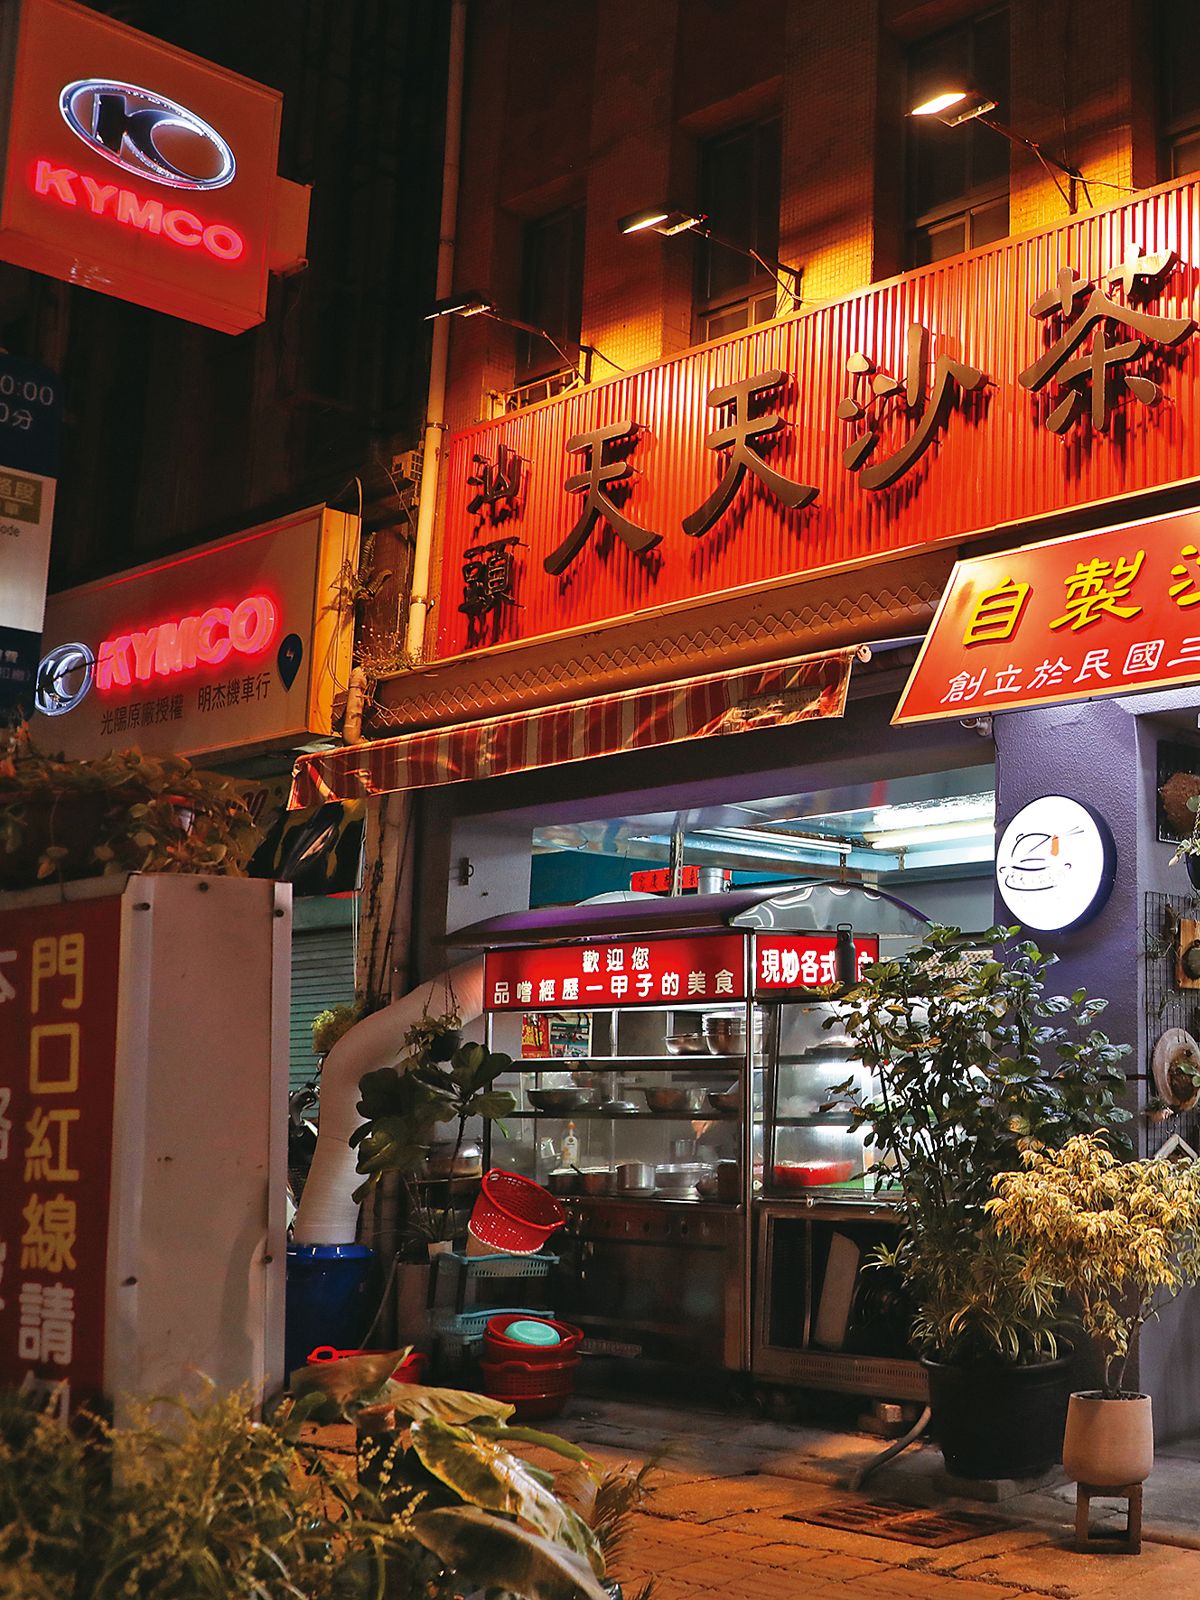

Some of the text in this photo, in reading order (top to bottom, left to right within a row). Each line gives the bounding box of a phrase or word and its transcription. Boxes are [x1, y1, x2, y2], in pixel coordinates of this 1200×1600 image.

[34, 160, 243, 260] KYMCO
[458, 444, 522, 613] 汕頭
[96, 596, 275, 689] KYMCO
[100, 672, 271, 735] 光陽原廠授權 明杰機車行
[582, 947, 650, 973] 歡迎您
